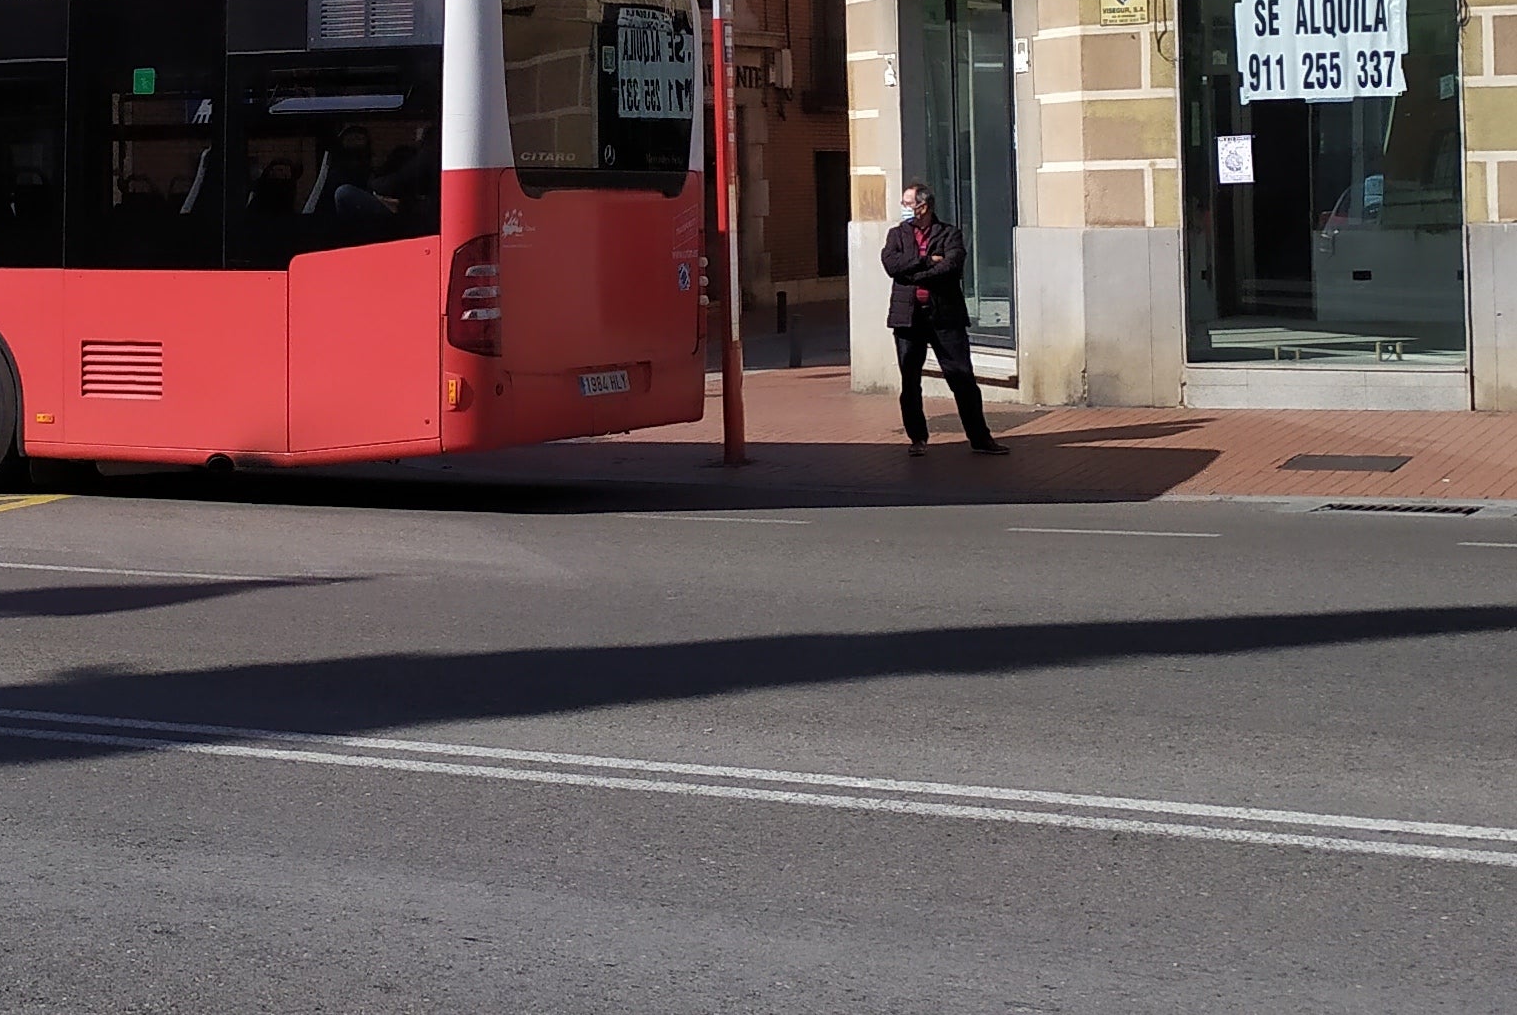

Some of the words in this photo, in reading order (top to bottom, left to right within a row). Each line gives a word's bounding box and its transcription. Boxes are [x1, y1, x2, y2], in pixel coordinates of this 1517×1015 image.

[1249, 52, 1285, 91] 911
[1302, 52, 1341, 89] 255
[1357, 50, 1395, 88] 337
[520, 152, 576, 161] CITARO
[586, 375, 608, 393] 1984
[609, 373, 627, 390] HLY
